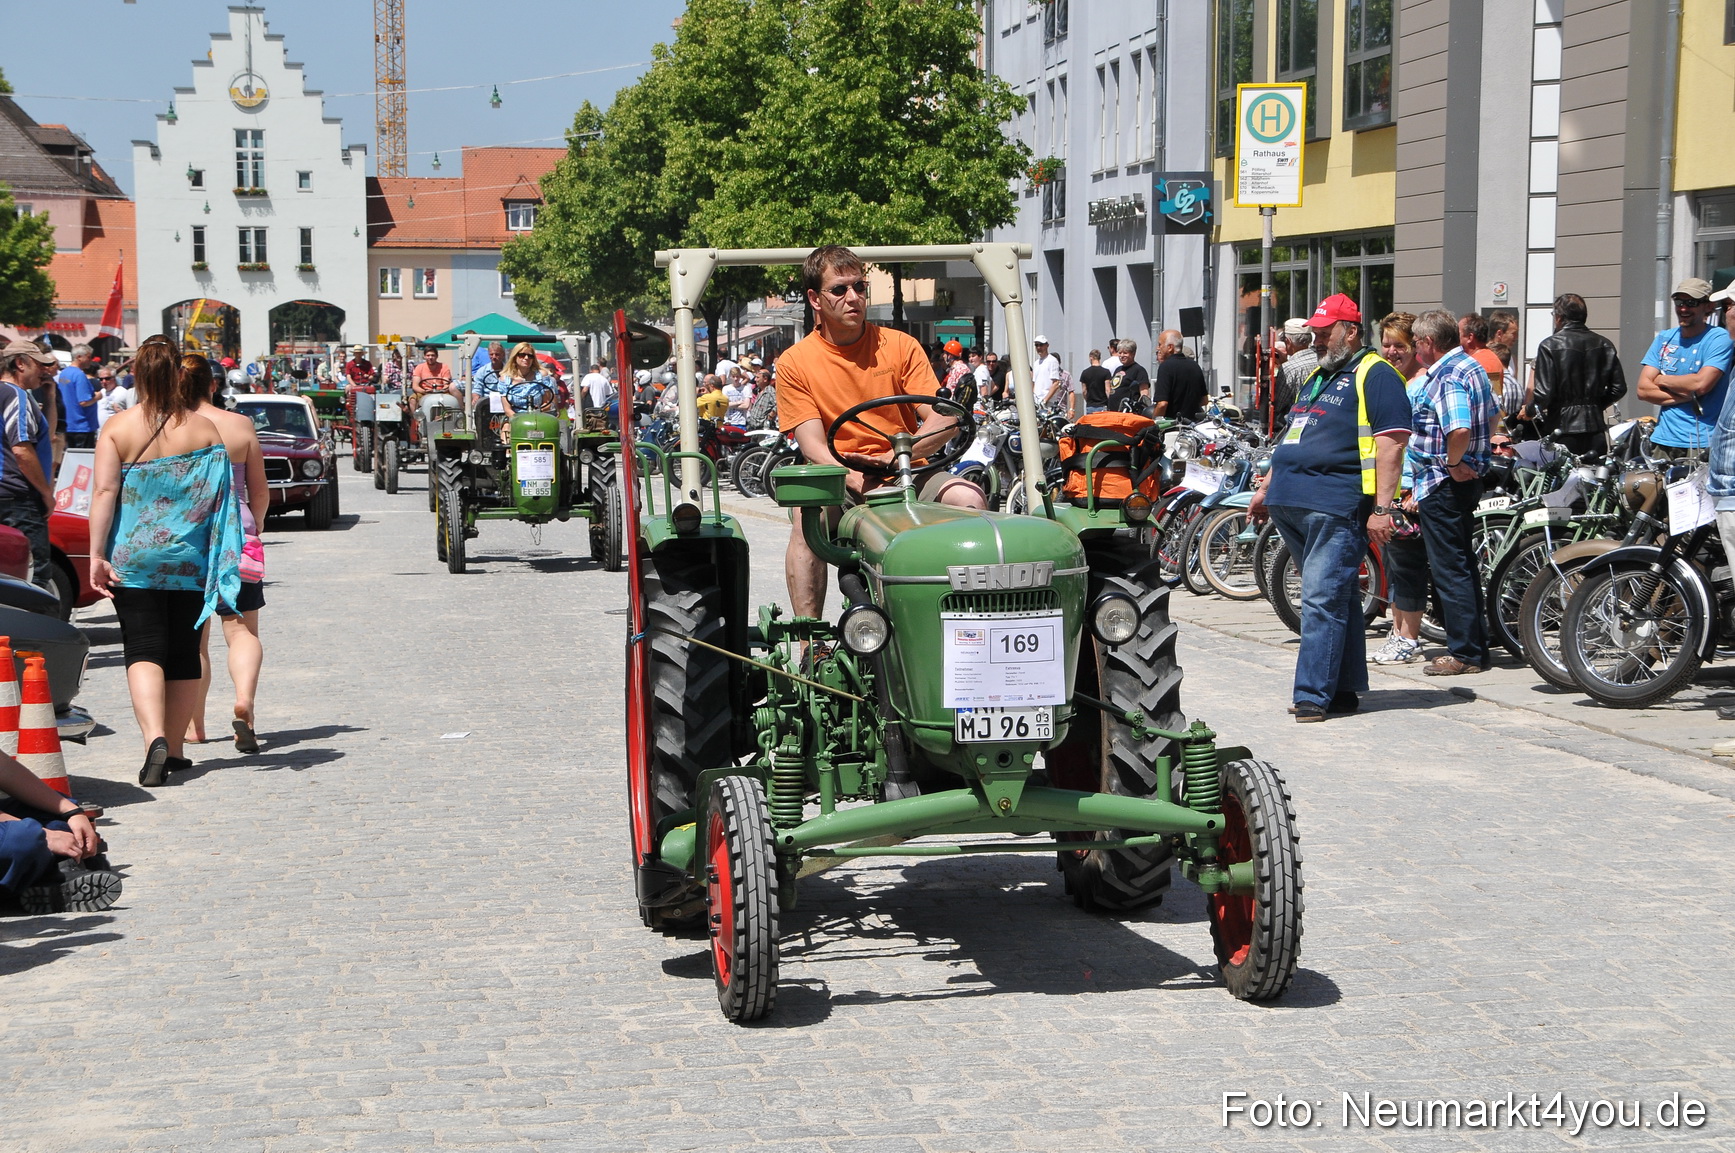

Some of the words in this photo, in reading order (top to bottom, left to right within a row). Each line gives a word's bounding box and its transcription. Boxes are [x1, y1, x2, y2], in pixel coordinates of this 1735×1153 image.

[1174, 188, 1196, 215] G2
[535, 487, 550, 496] 855
[1488, 499, 1505, 508] 102
[947, 562, 1054, 591] FENDT
[1000, 633, 1040, 654] 169
[1035, 713, 1050, 723] 03
[961, 716, 991, 739] MJ
[1000, 715, 1029, 738] 96
[1036, 727, 1050, 737] 10
